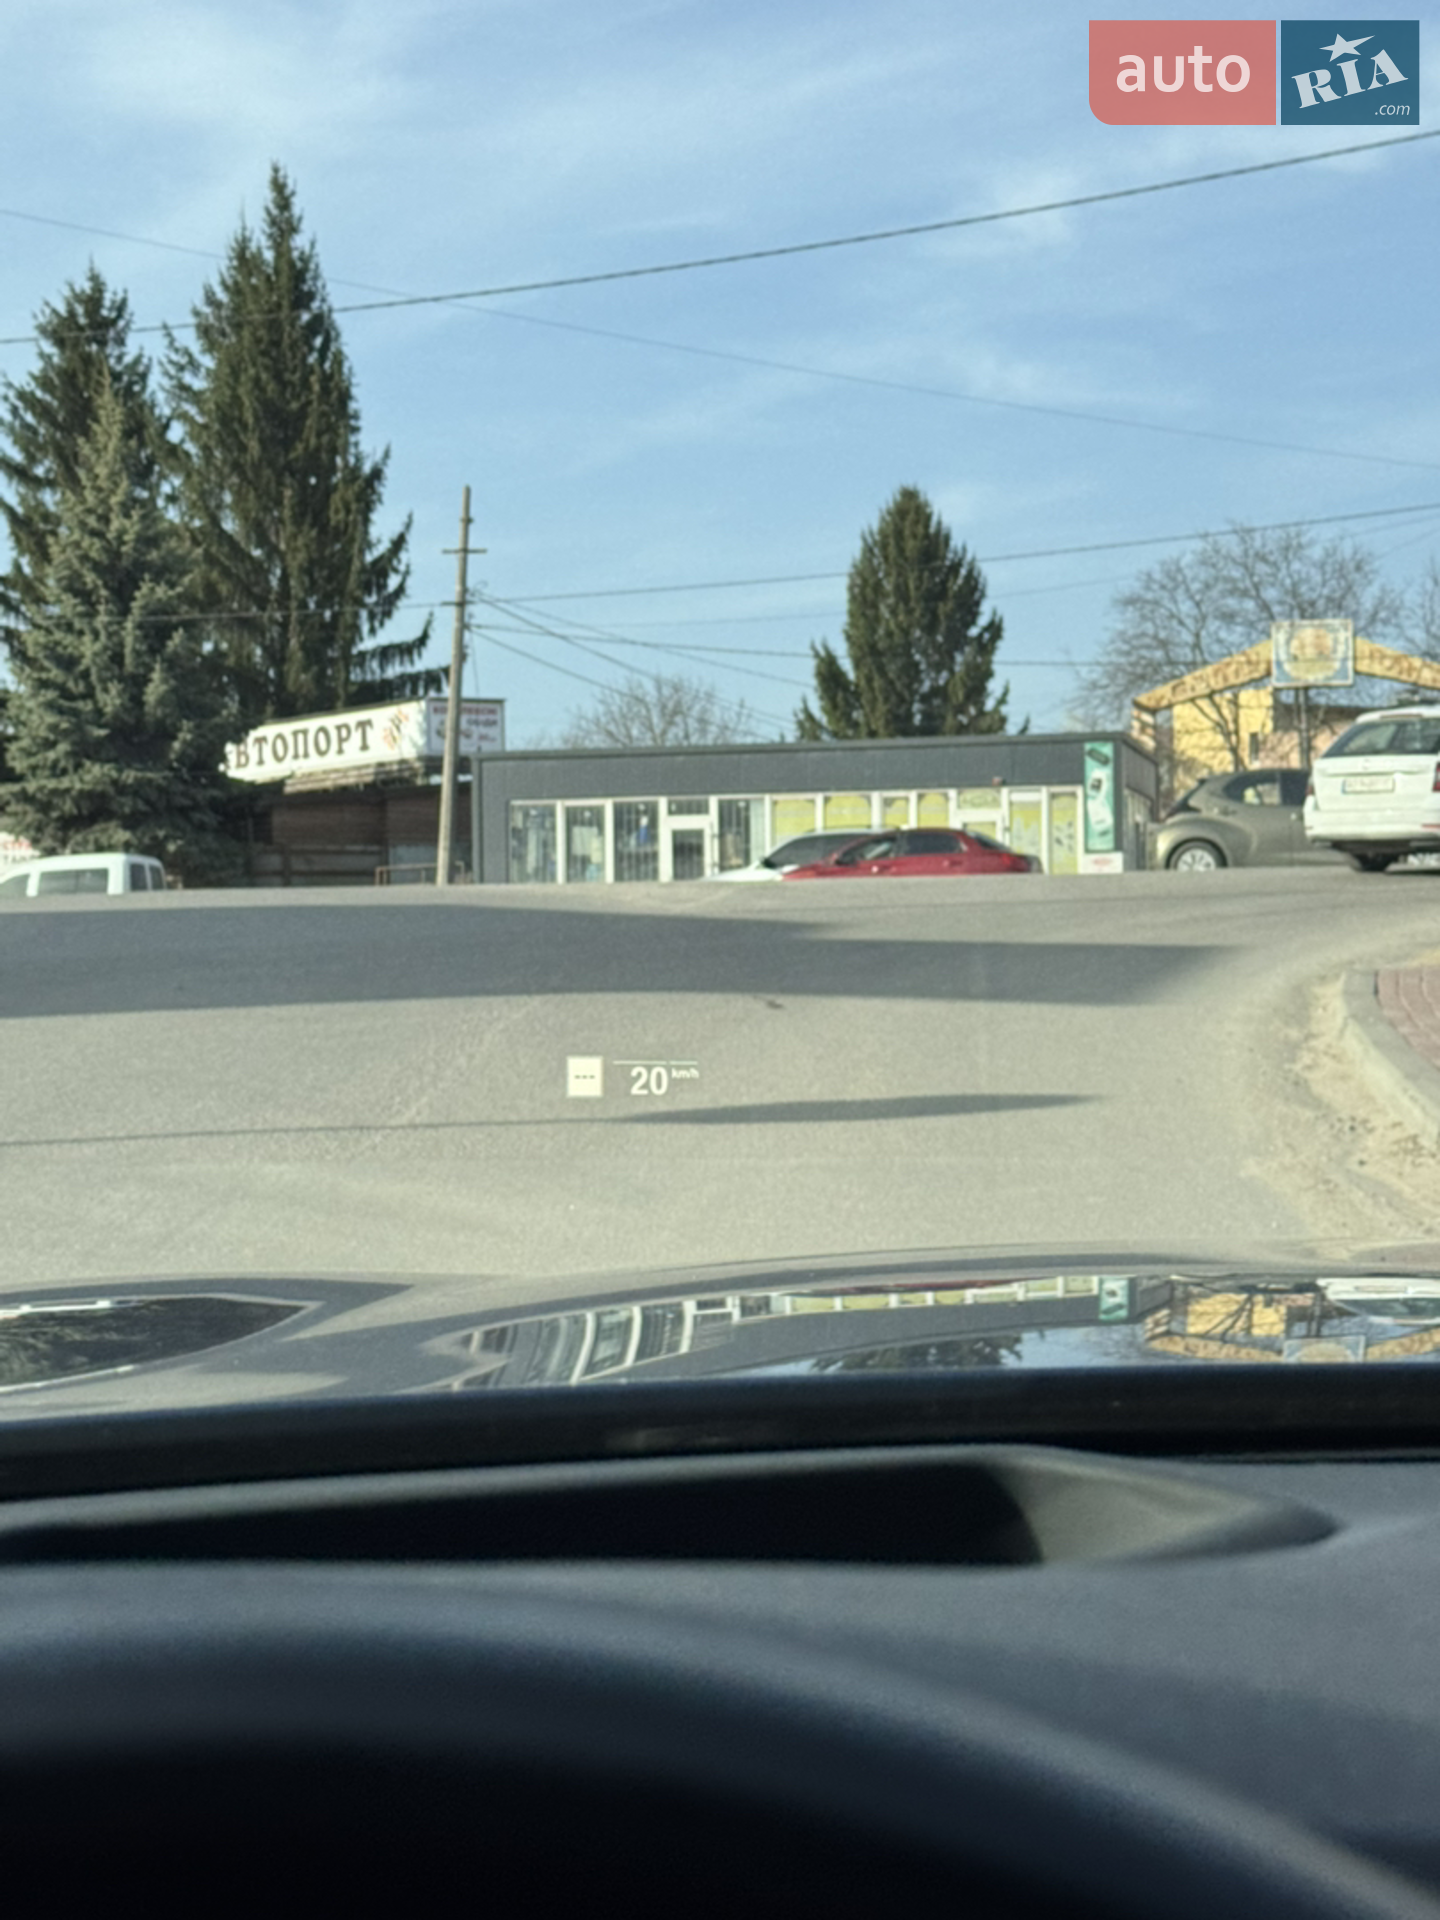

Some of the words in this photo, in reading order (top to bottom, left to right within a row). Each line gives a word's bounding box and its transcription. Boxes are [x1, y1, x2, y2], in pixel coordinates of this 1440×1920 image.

[224, 719, 374, 770] ВТОПОРТ
[630, 1066, 669, 1096] 20
[671, 1067, 700, 1079] km/h
